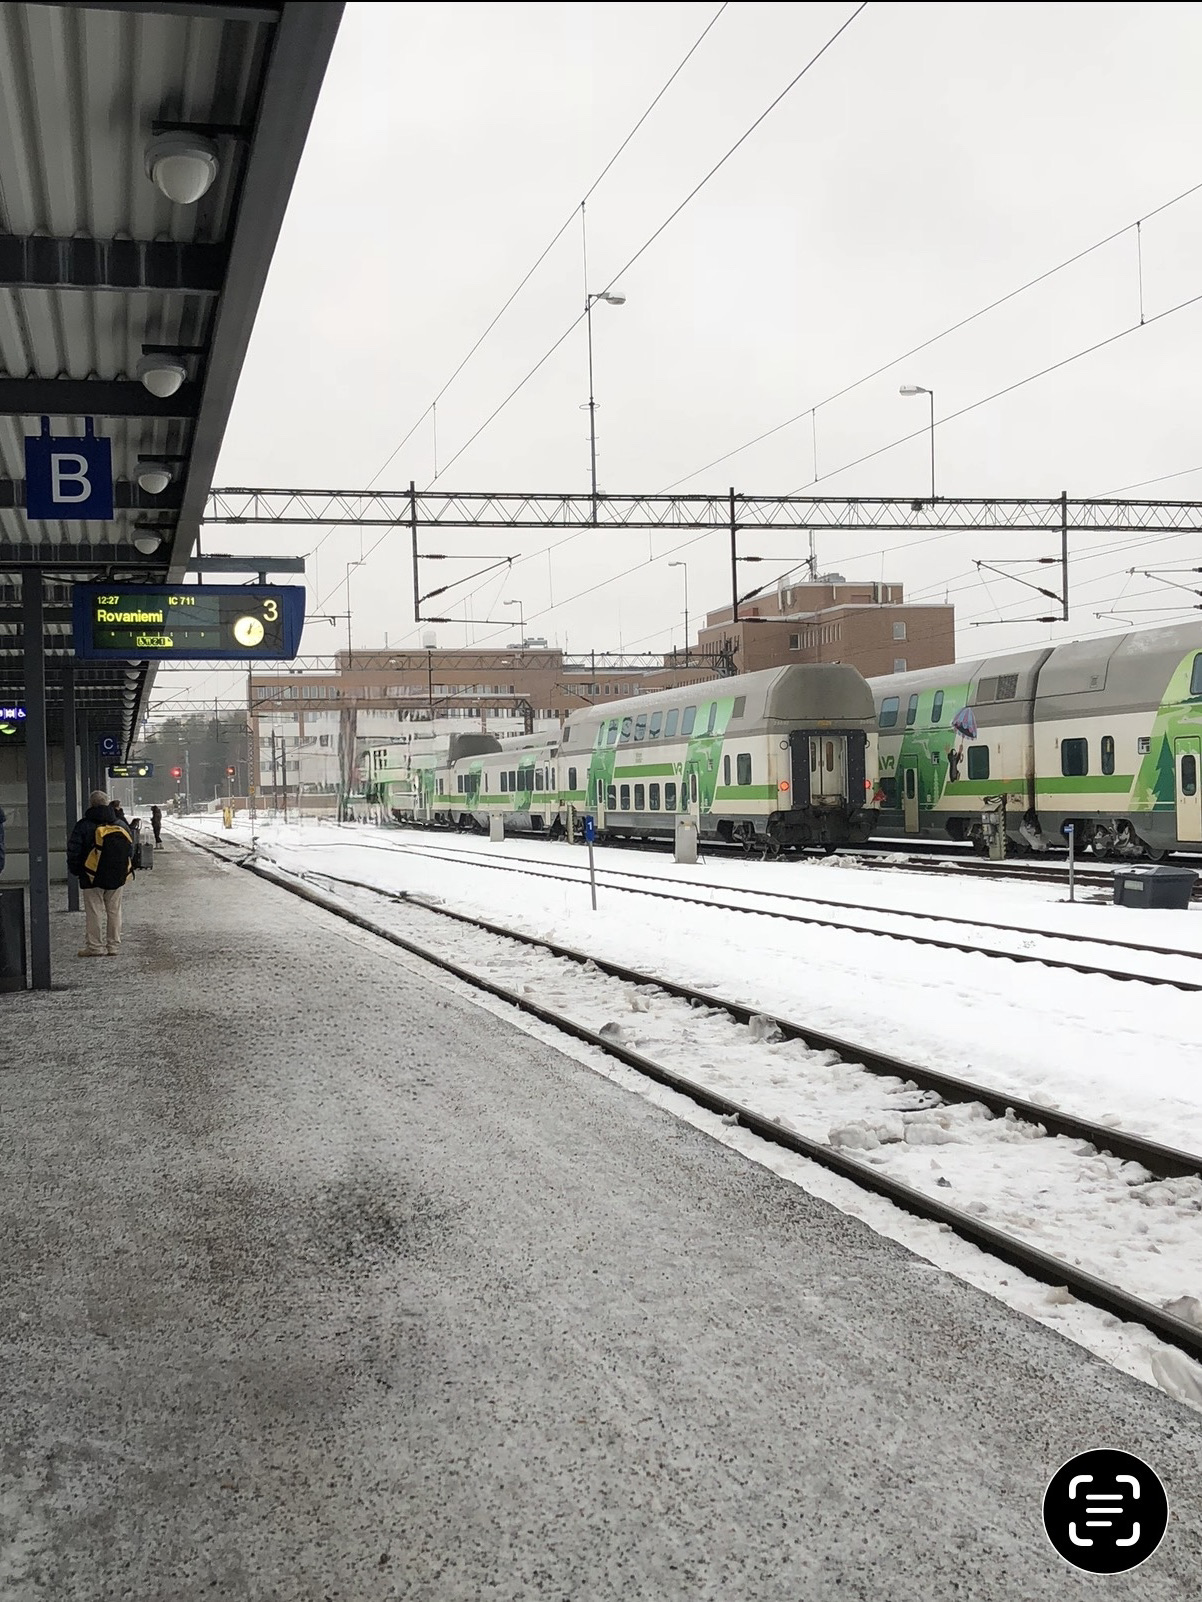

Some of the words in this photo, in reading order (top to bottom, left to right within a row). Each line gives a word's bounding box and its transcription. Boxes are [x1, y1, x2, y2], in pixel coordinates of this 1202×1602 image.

[51, 453, 92, 503] B
[97, 596, 119, 605] 12:27
[168, 597, 178, 606] IC
[180, 597, 195, 606] 711
[97, 609, 163, 623] Rovaniemi
[263, 599, 278, 621] 3
[103, 738, 114, 750] C
[673, 761, 683, 776] VR
[881, 755, 895, 770] VR
[587, 821, 593, 831] 1
